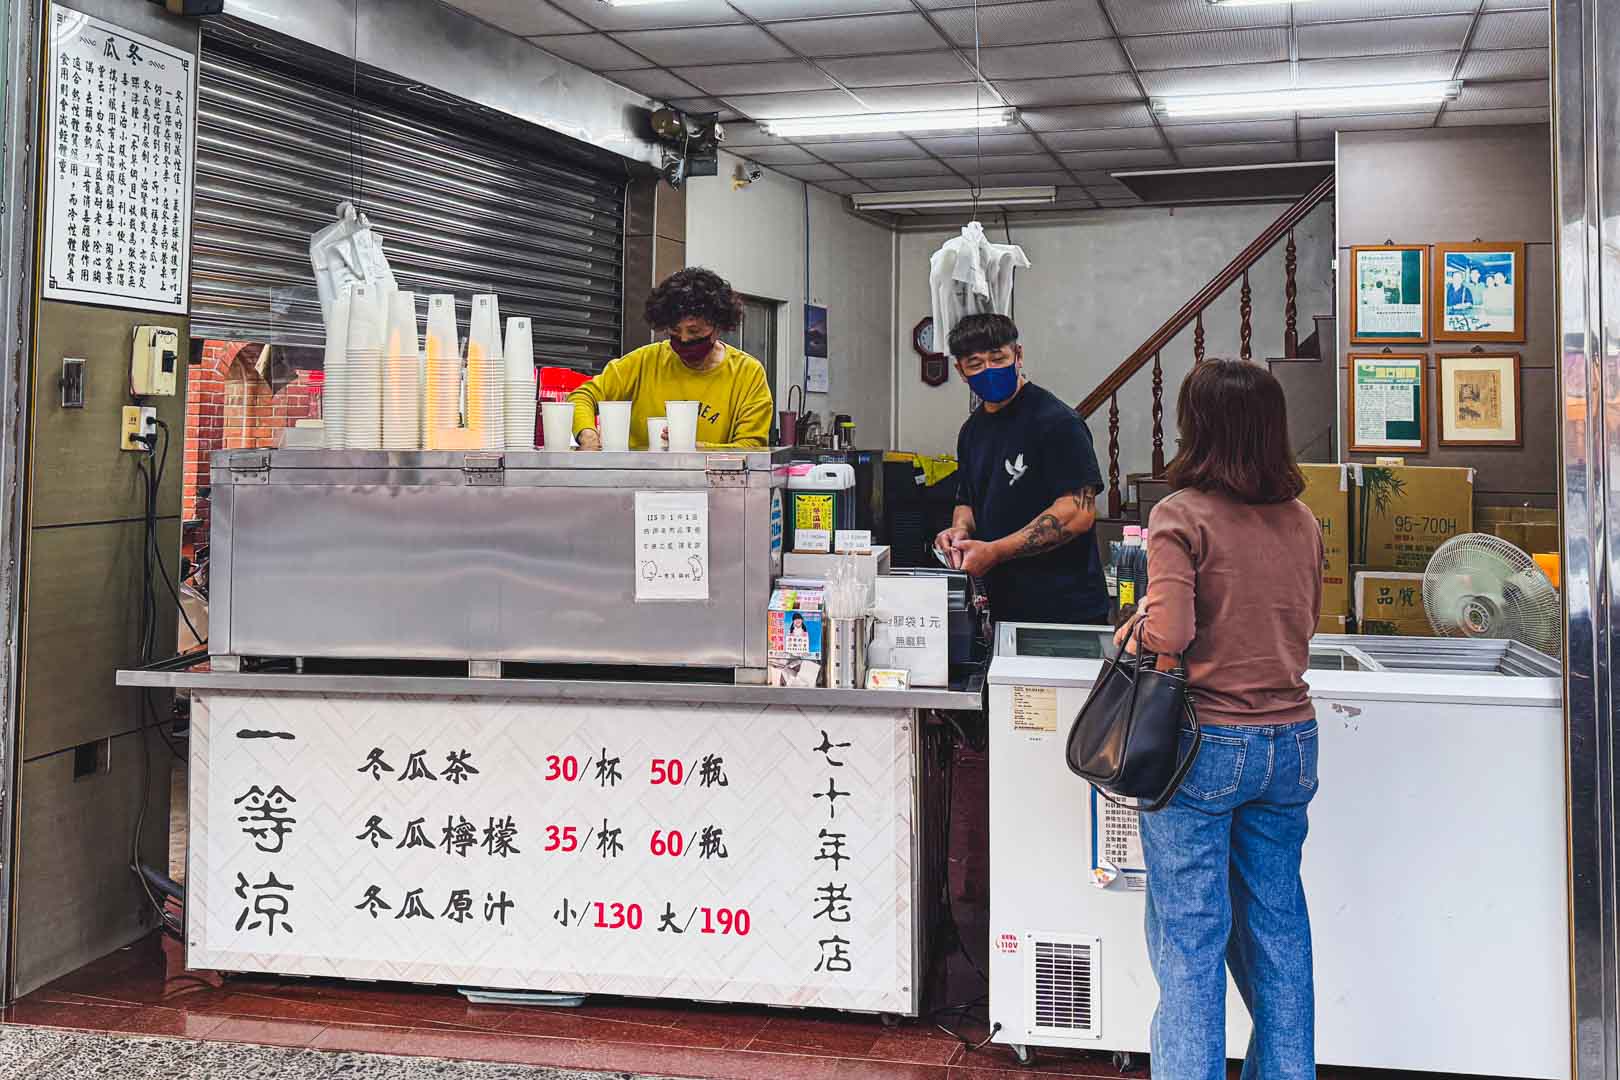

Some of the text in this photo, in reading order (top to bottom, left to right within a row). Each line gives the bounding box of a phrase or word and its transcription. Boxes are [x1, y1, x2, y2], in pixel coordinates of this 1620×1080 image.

[358, 748, 728, 787] 冬瓜茶 30/杯 50/瓶
[235, 730, 296, 935] 一等涼
[356, 816, 728, 859] 冬瓜檸檬 35/杯 60/瓶
[813, 731, 851, 971] 七十年老店
[356, 885, 750, 936] 冬瓜原汁 小/130 大/190
